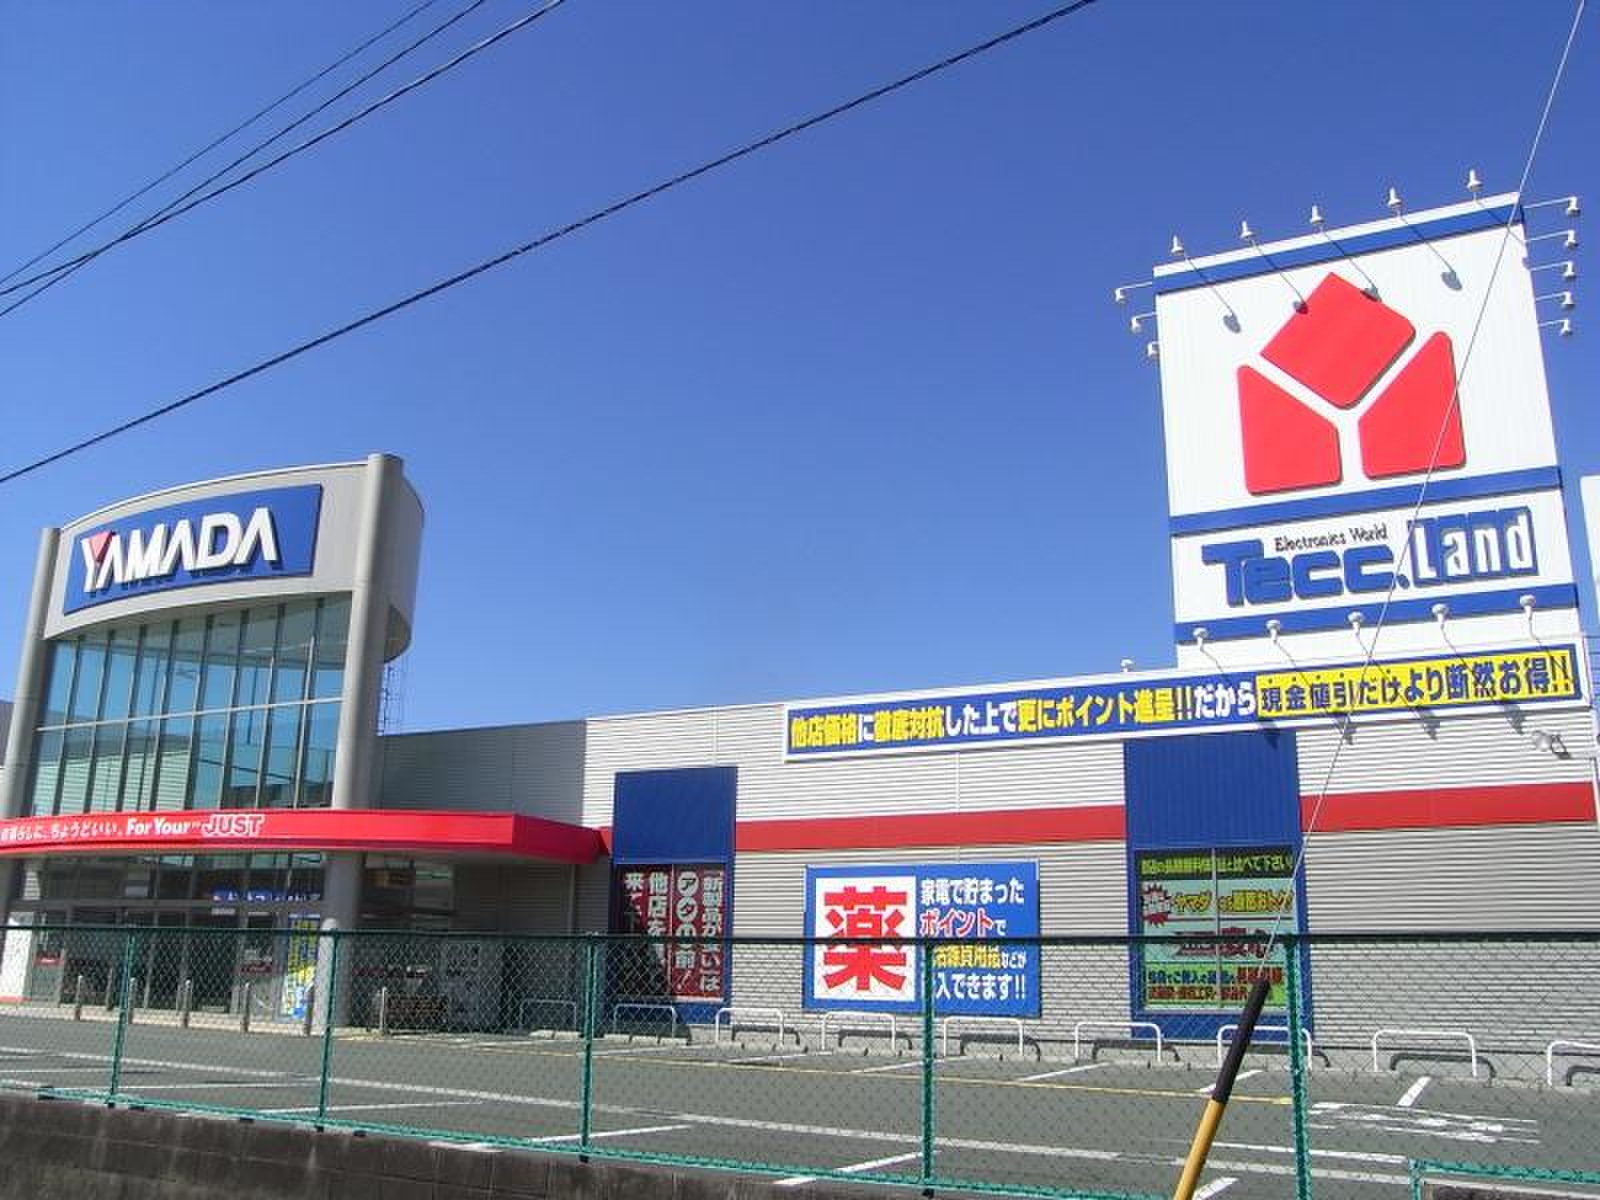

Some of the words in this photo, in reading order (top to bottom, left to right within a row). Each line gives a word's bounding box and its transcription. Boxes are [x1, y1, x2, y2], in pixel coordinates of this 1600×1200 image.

[81, 507, 278, 593] YAMADA
[1274, 531, 1346, 552] Electronics
[1349, 523, 1388, 542] World
[125, 818, 152, 836] For
[202, 814, 265, 837] JUST
[919, 907, 1007, 938] ポイントで
[823, 886, 907, 991] 薬
[921, 972, 1026, 1001] 入できます!!
